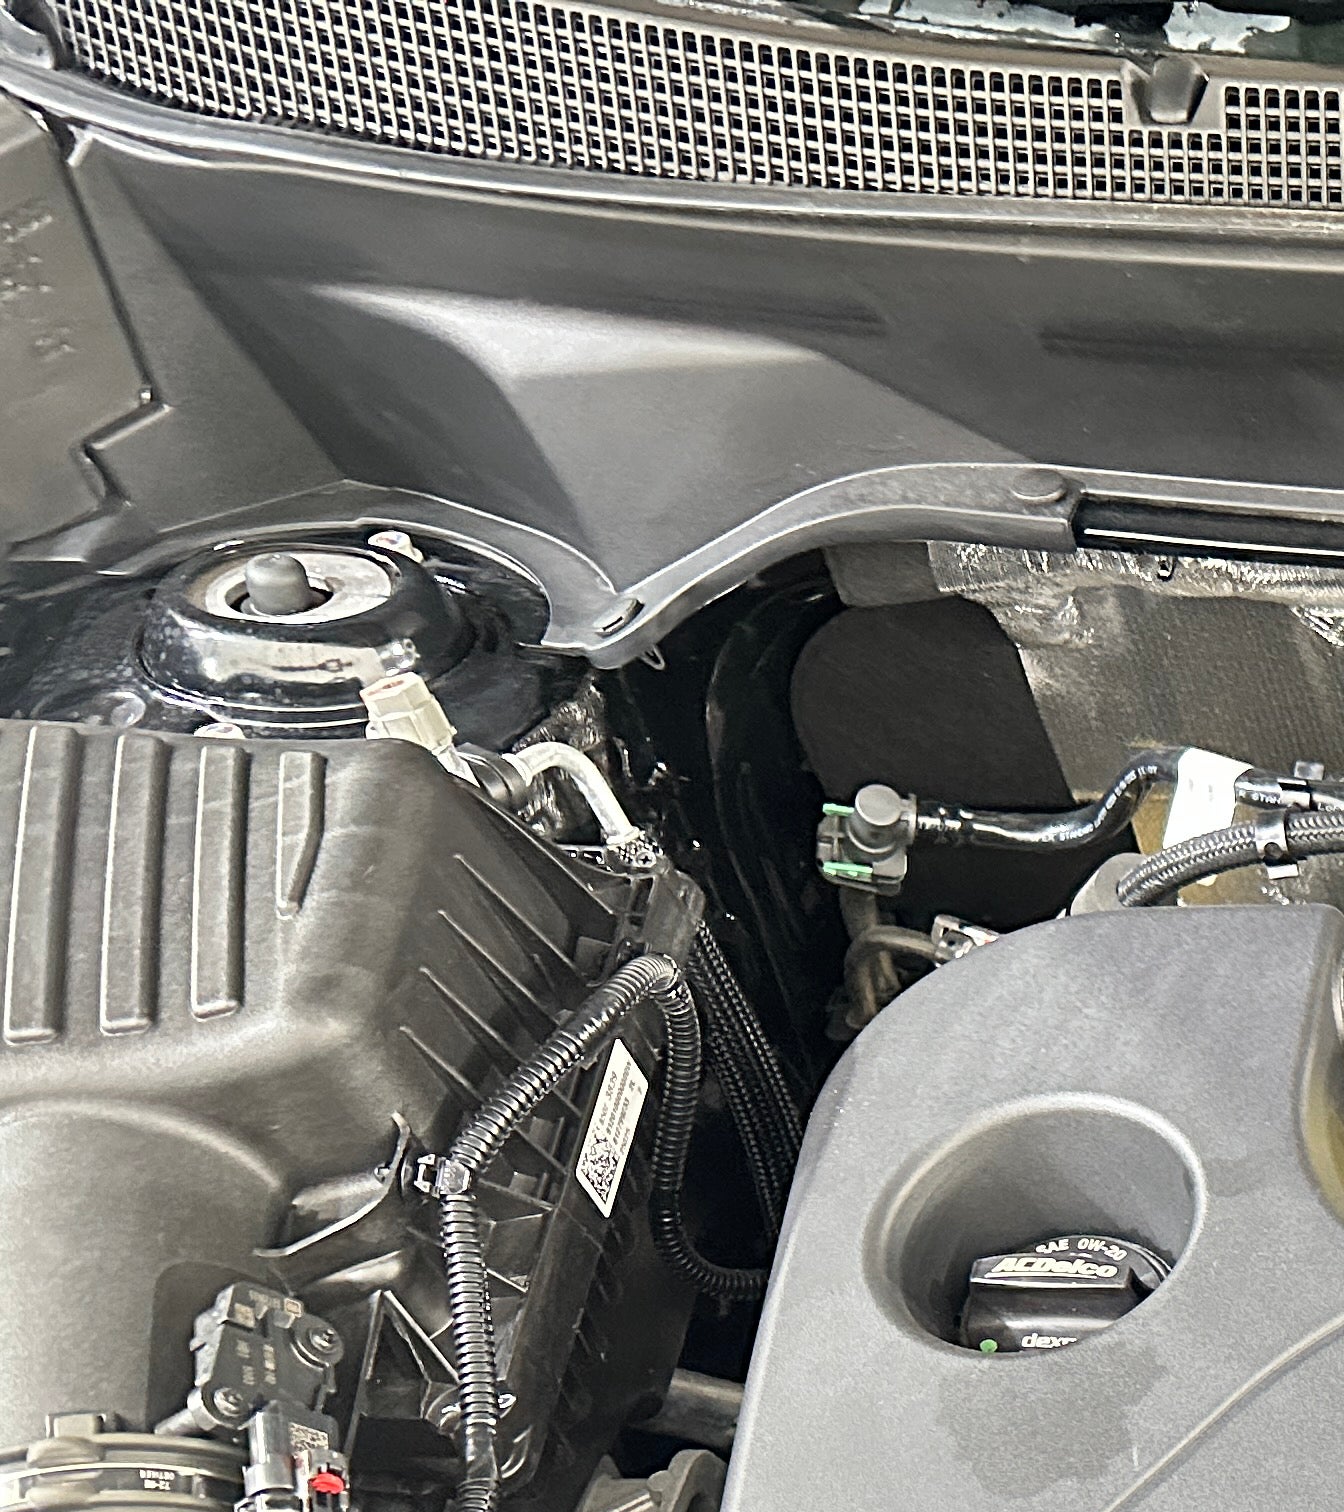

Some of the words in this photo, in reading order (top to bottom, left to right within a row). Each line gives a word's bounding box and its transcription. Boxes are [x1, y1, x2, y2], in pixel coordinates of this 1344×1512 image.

[1035, 1238, 1070, 1254] SAE
[1077, 1238, 1128, 1262] 0W-20
[991, 1257, 1118, 1278] ACDelco
[1021, 1333, 1078, 1349] dex
